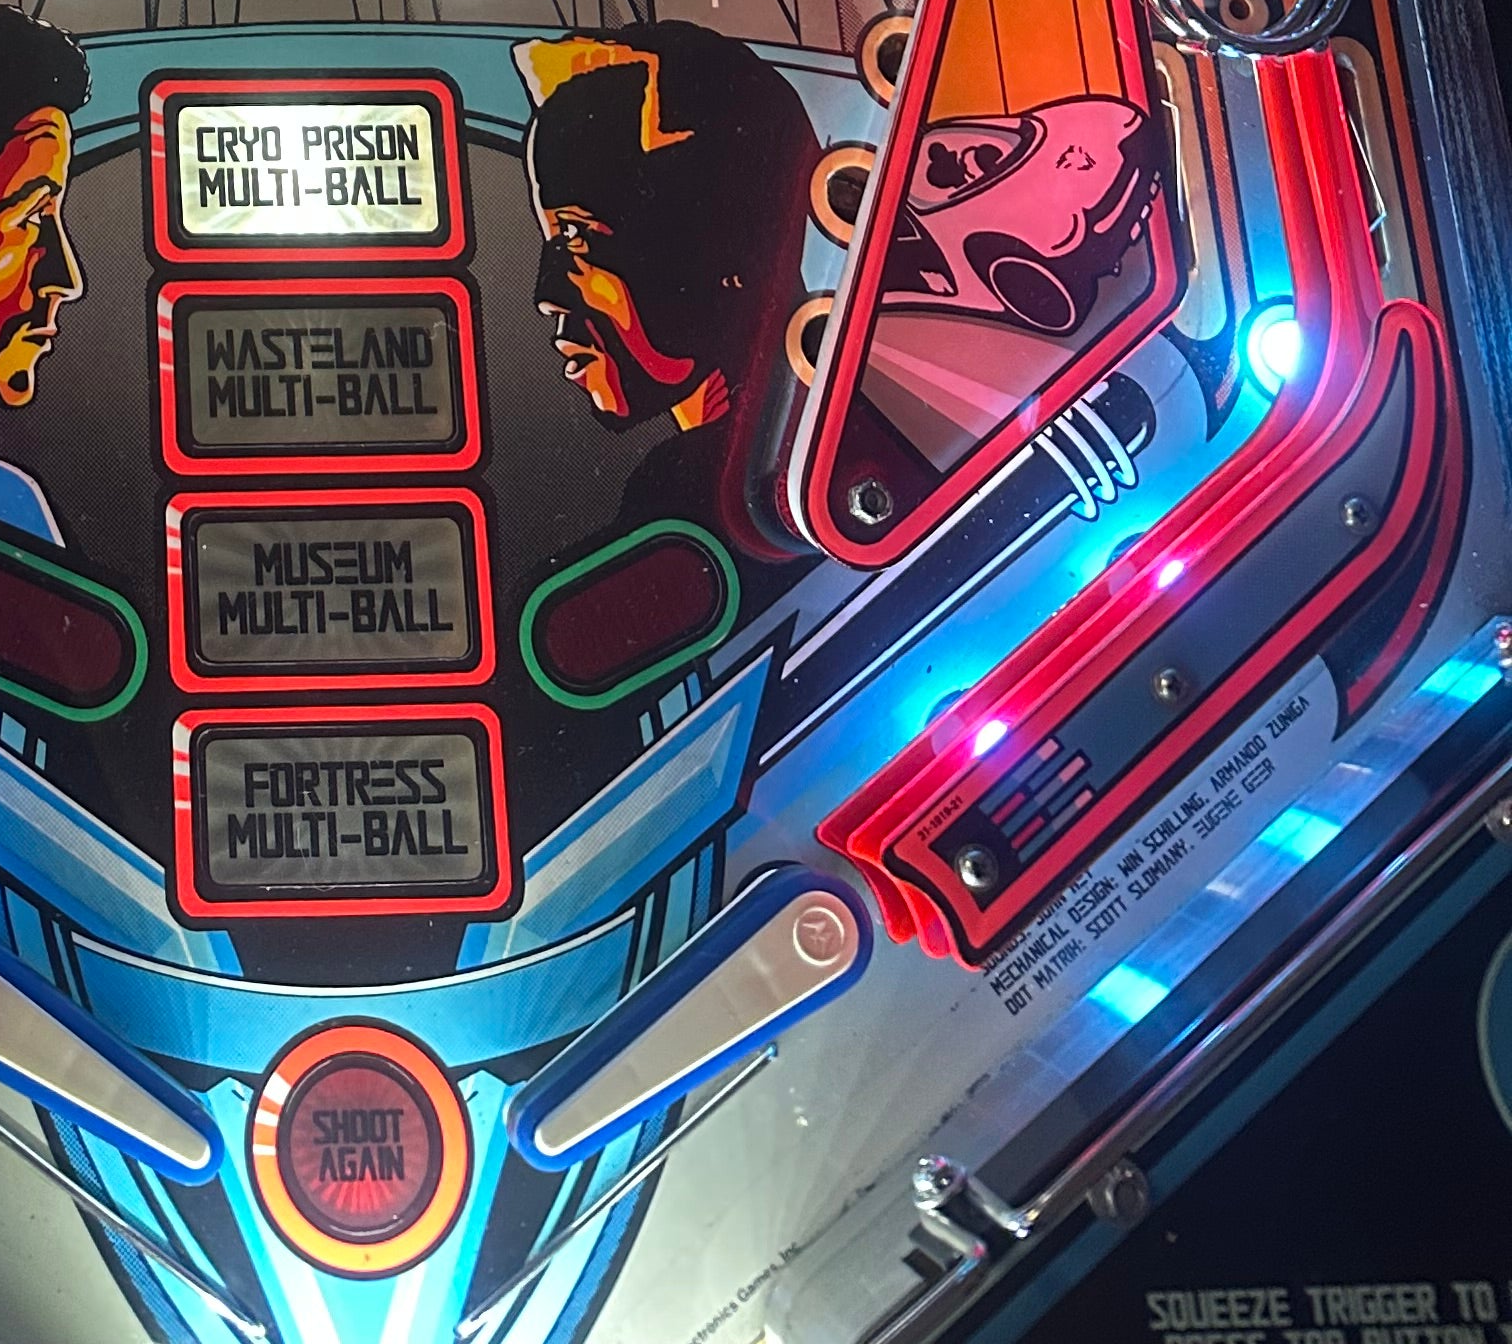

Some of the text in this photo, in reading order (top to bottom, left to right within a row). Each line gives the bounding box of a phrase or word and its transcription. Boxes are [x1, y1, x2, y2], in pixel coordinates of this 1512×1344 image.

[196, 124, 419, 163] CRYO PRISON
[199, 166, 423, 208] MULTI-BALL
[207, 328, 433, 370] WASTELAND
[208, 375, 438, 418] MULTI-BALL
[255, 541, 413, 585] MUSEUM
[219, 588, 453, 635] MULTI-BALL
[245, 759, 447, 808] FORTRESS
[229, 809, 469, 860] MULTI-BALL
[992, 923, 1067, 996] MECHANICAL
[1069, 875, 1118, 923] DESIGN:
[1118, 852, 1144, 877] WIN
[1209, 736, 1266, 792] ARMANDO
[1267, 696, 1309, 737] ZUNIGA
[1006, 989, 1032, 1015] DOT
[1088, 899, 1128, 939] SCOTT
[1194, 792, 1242, 839] EUGENE
[1242, 760, 1276, 793] GEER
[313, 1108, 405, 1144] SHOOT
[319, 1145, 406, 1182] AGAIN
[1145, 1288, 1292, 1331] SQUEEZE
[1304, 1283, 1439, 1327] TRIGGER
[1451, 1280, 1499, 1322] TO
